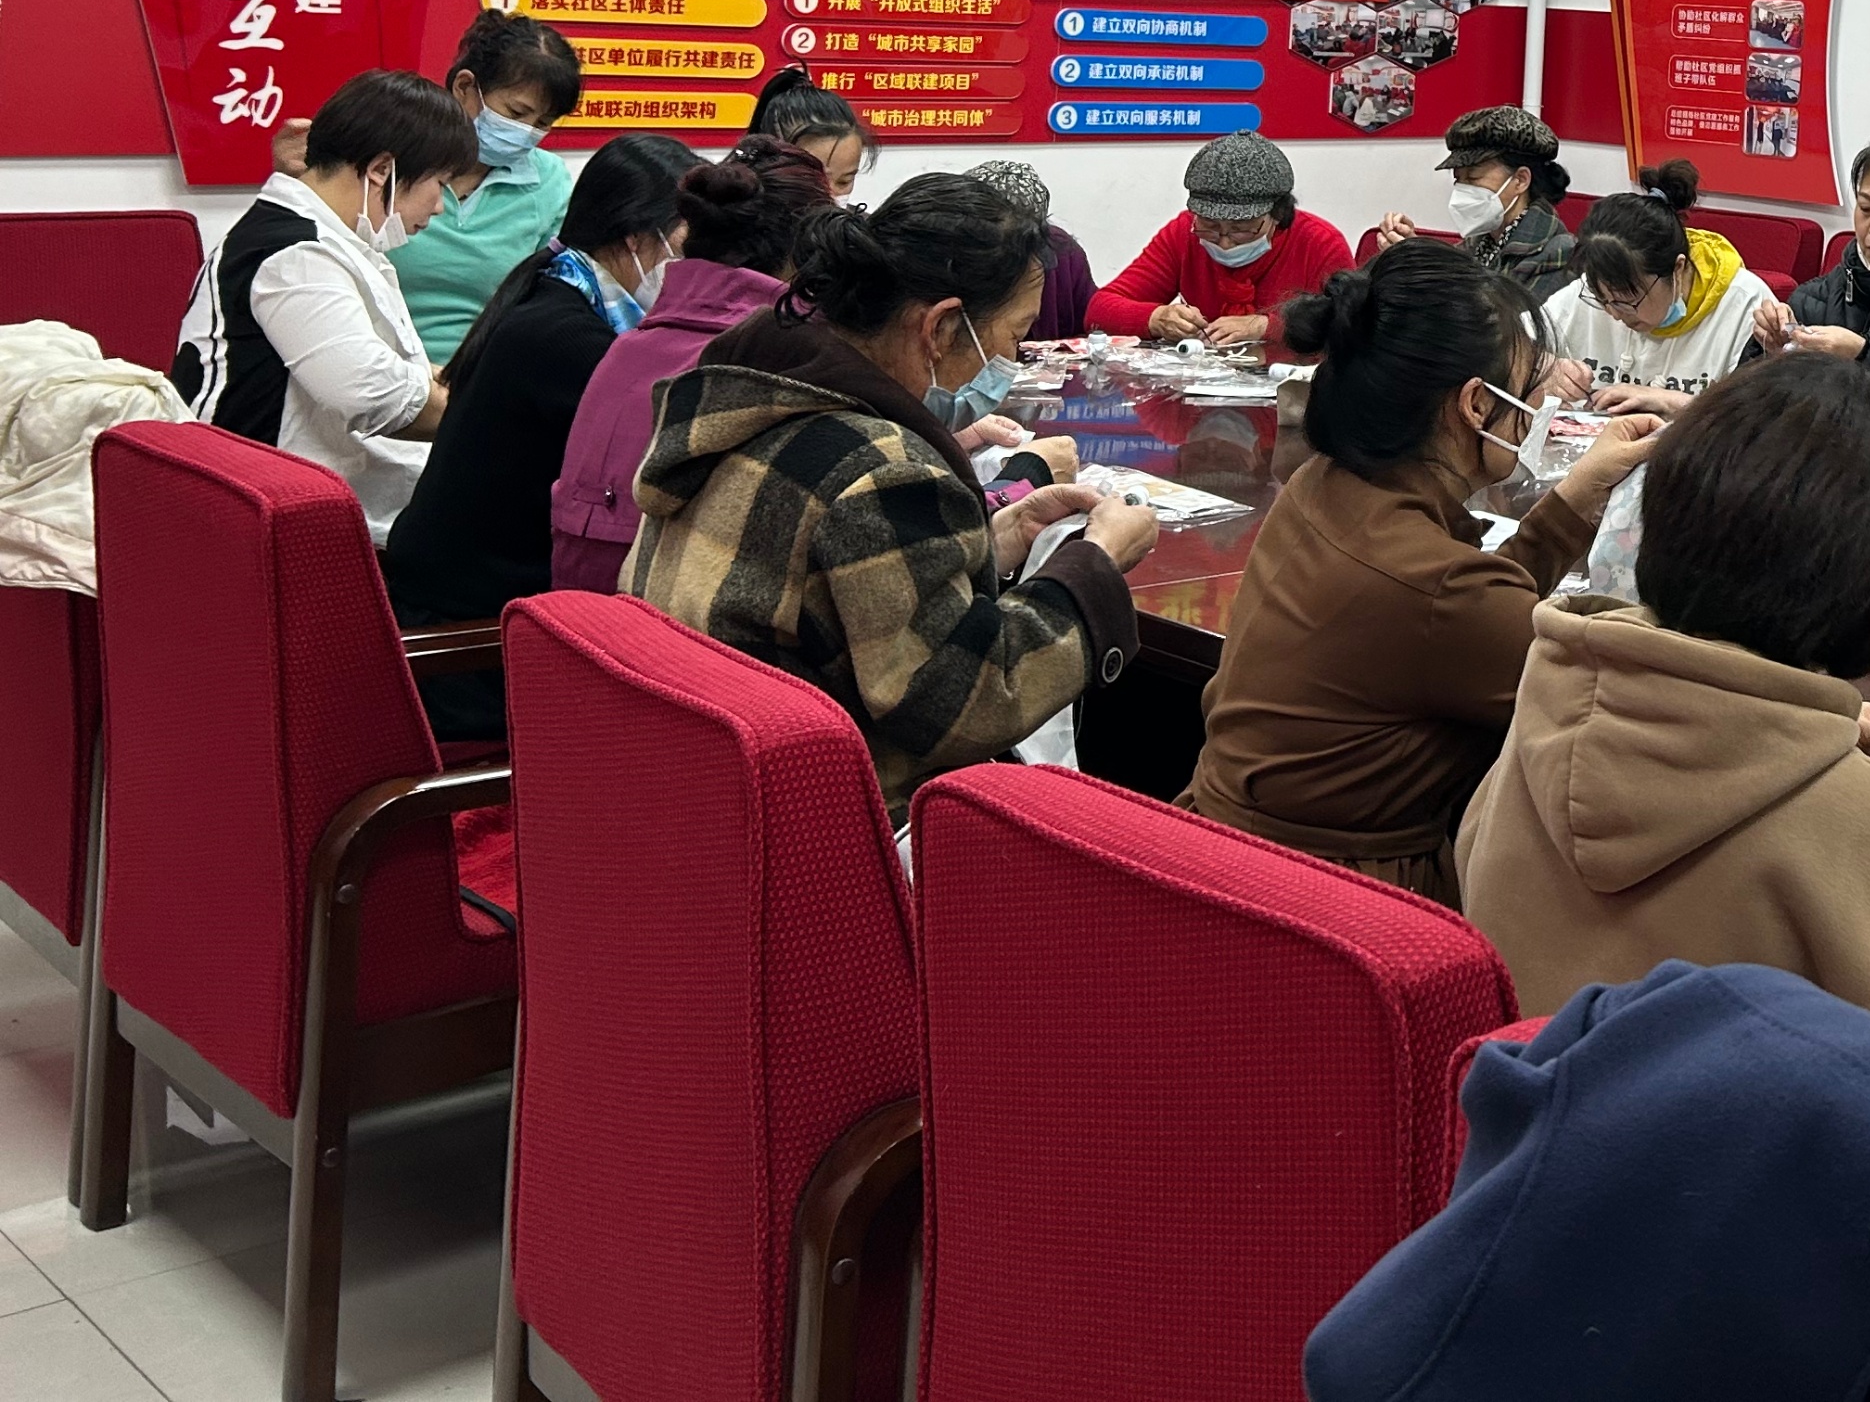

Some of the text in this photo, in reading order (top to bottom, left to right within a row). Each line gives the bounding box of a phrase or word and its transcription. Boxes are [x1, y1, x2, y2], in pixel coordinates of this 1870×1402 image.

[1092, 16, 1208, 38] 建立双向协商机制
[1088, 63, 1204, 83] 建立双向承诺机制
[1085, 108, 1202, 127] 建立双向服务机制
